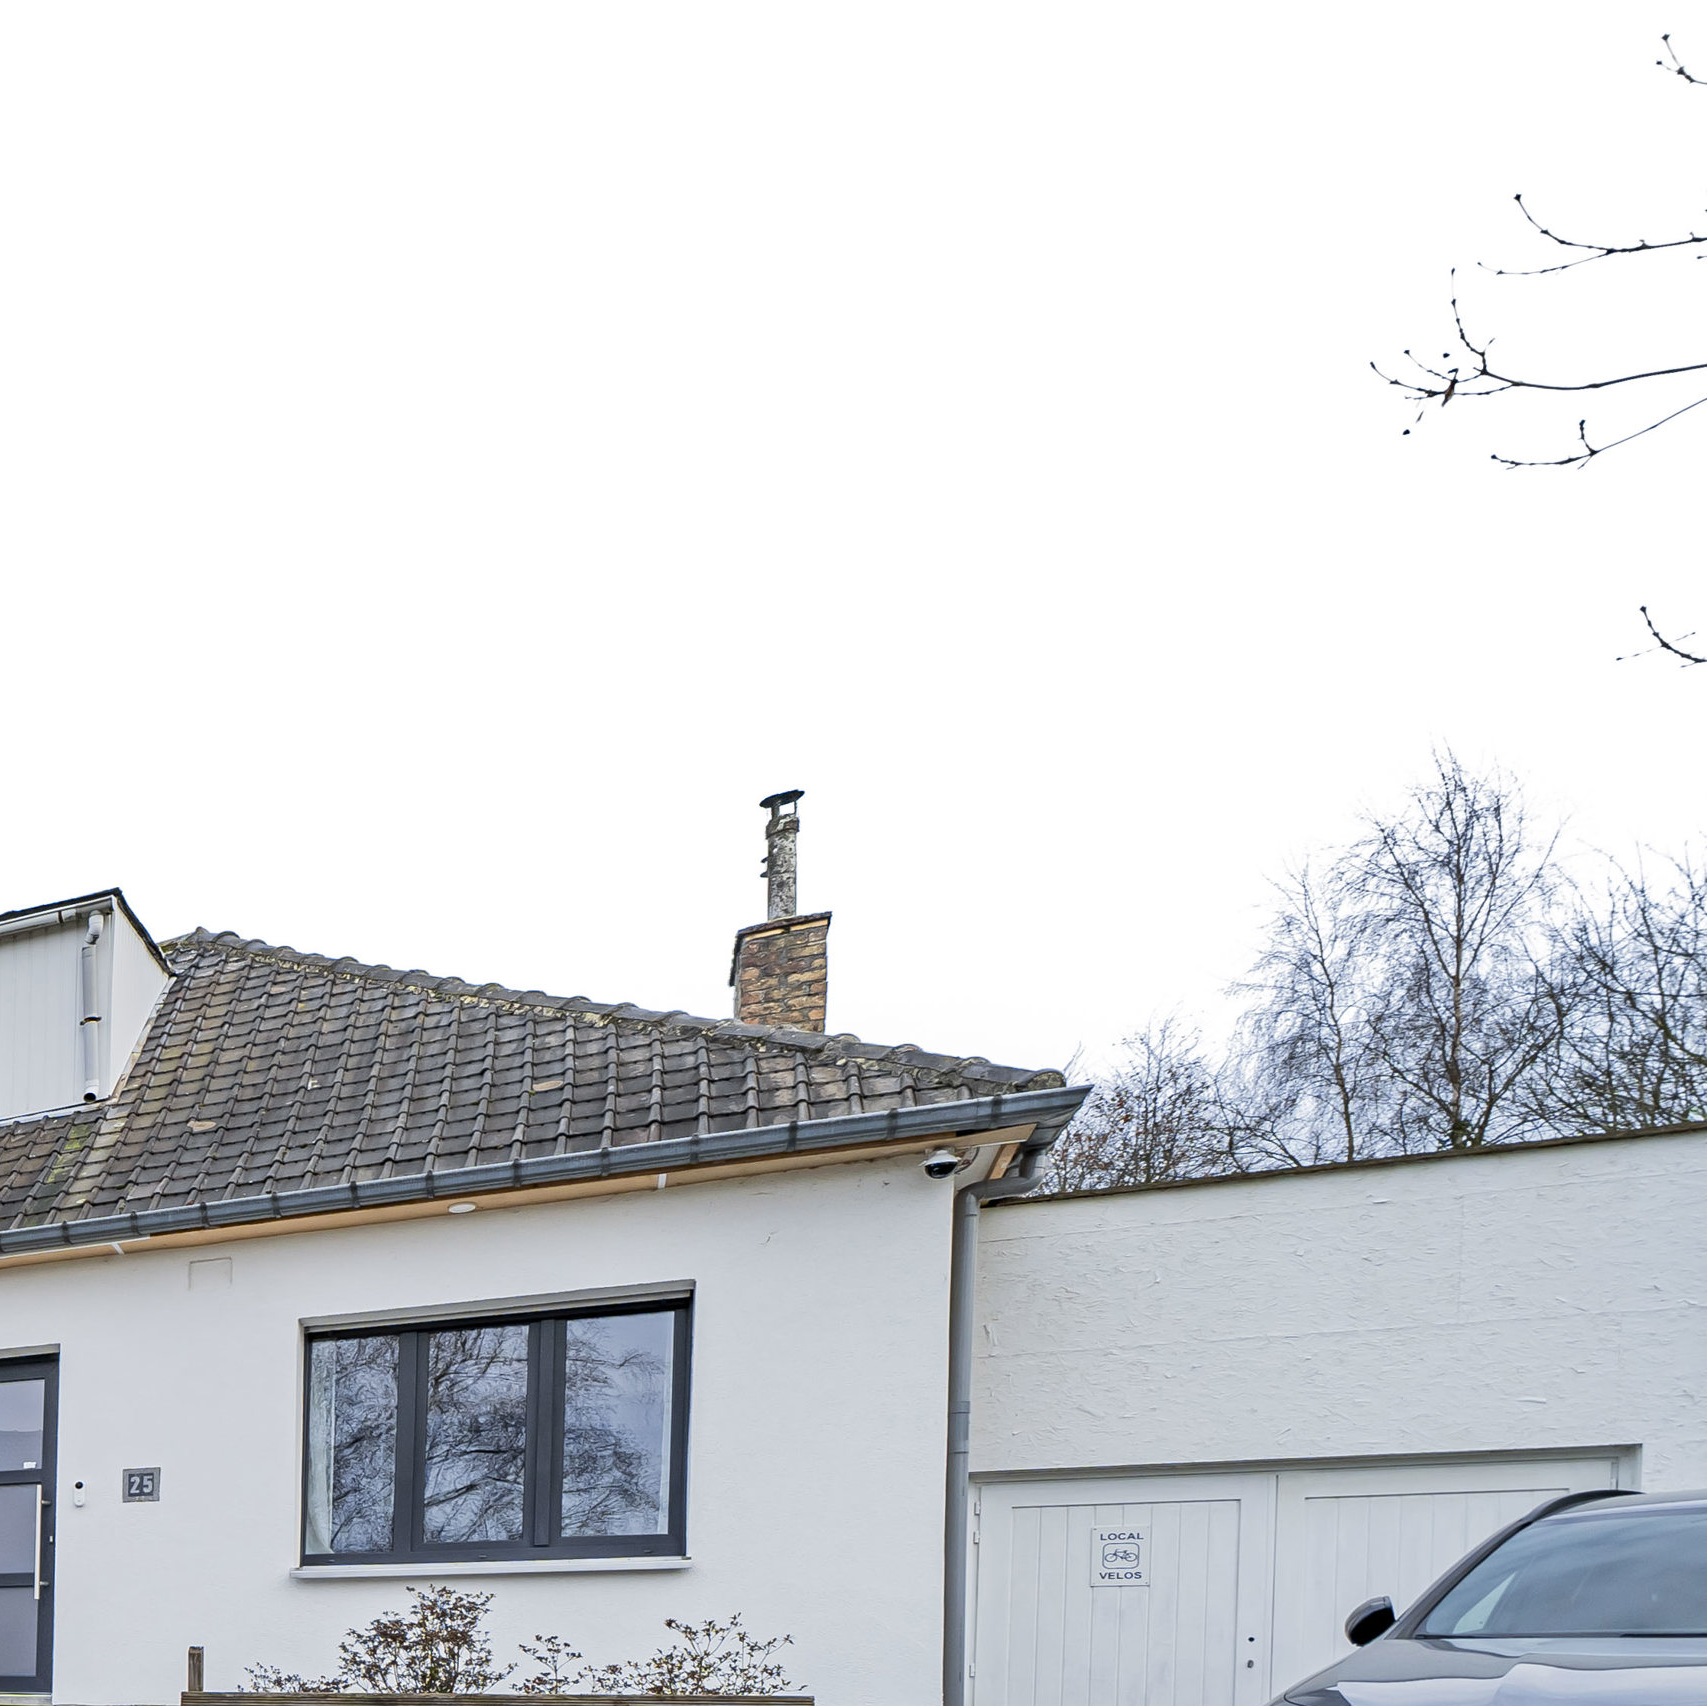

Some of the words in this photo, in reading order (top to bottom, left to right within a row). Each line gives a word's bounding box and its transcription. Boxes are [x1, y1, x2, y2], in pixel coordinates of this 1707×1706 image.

[130, 1475, 153, 1494] 25
[1099, 1532, 1144, 1541] LOCAL
[1099, 1571, 1142, 1580] VELOS
